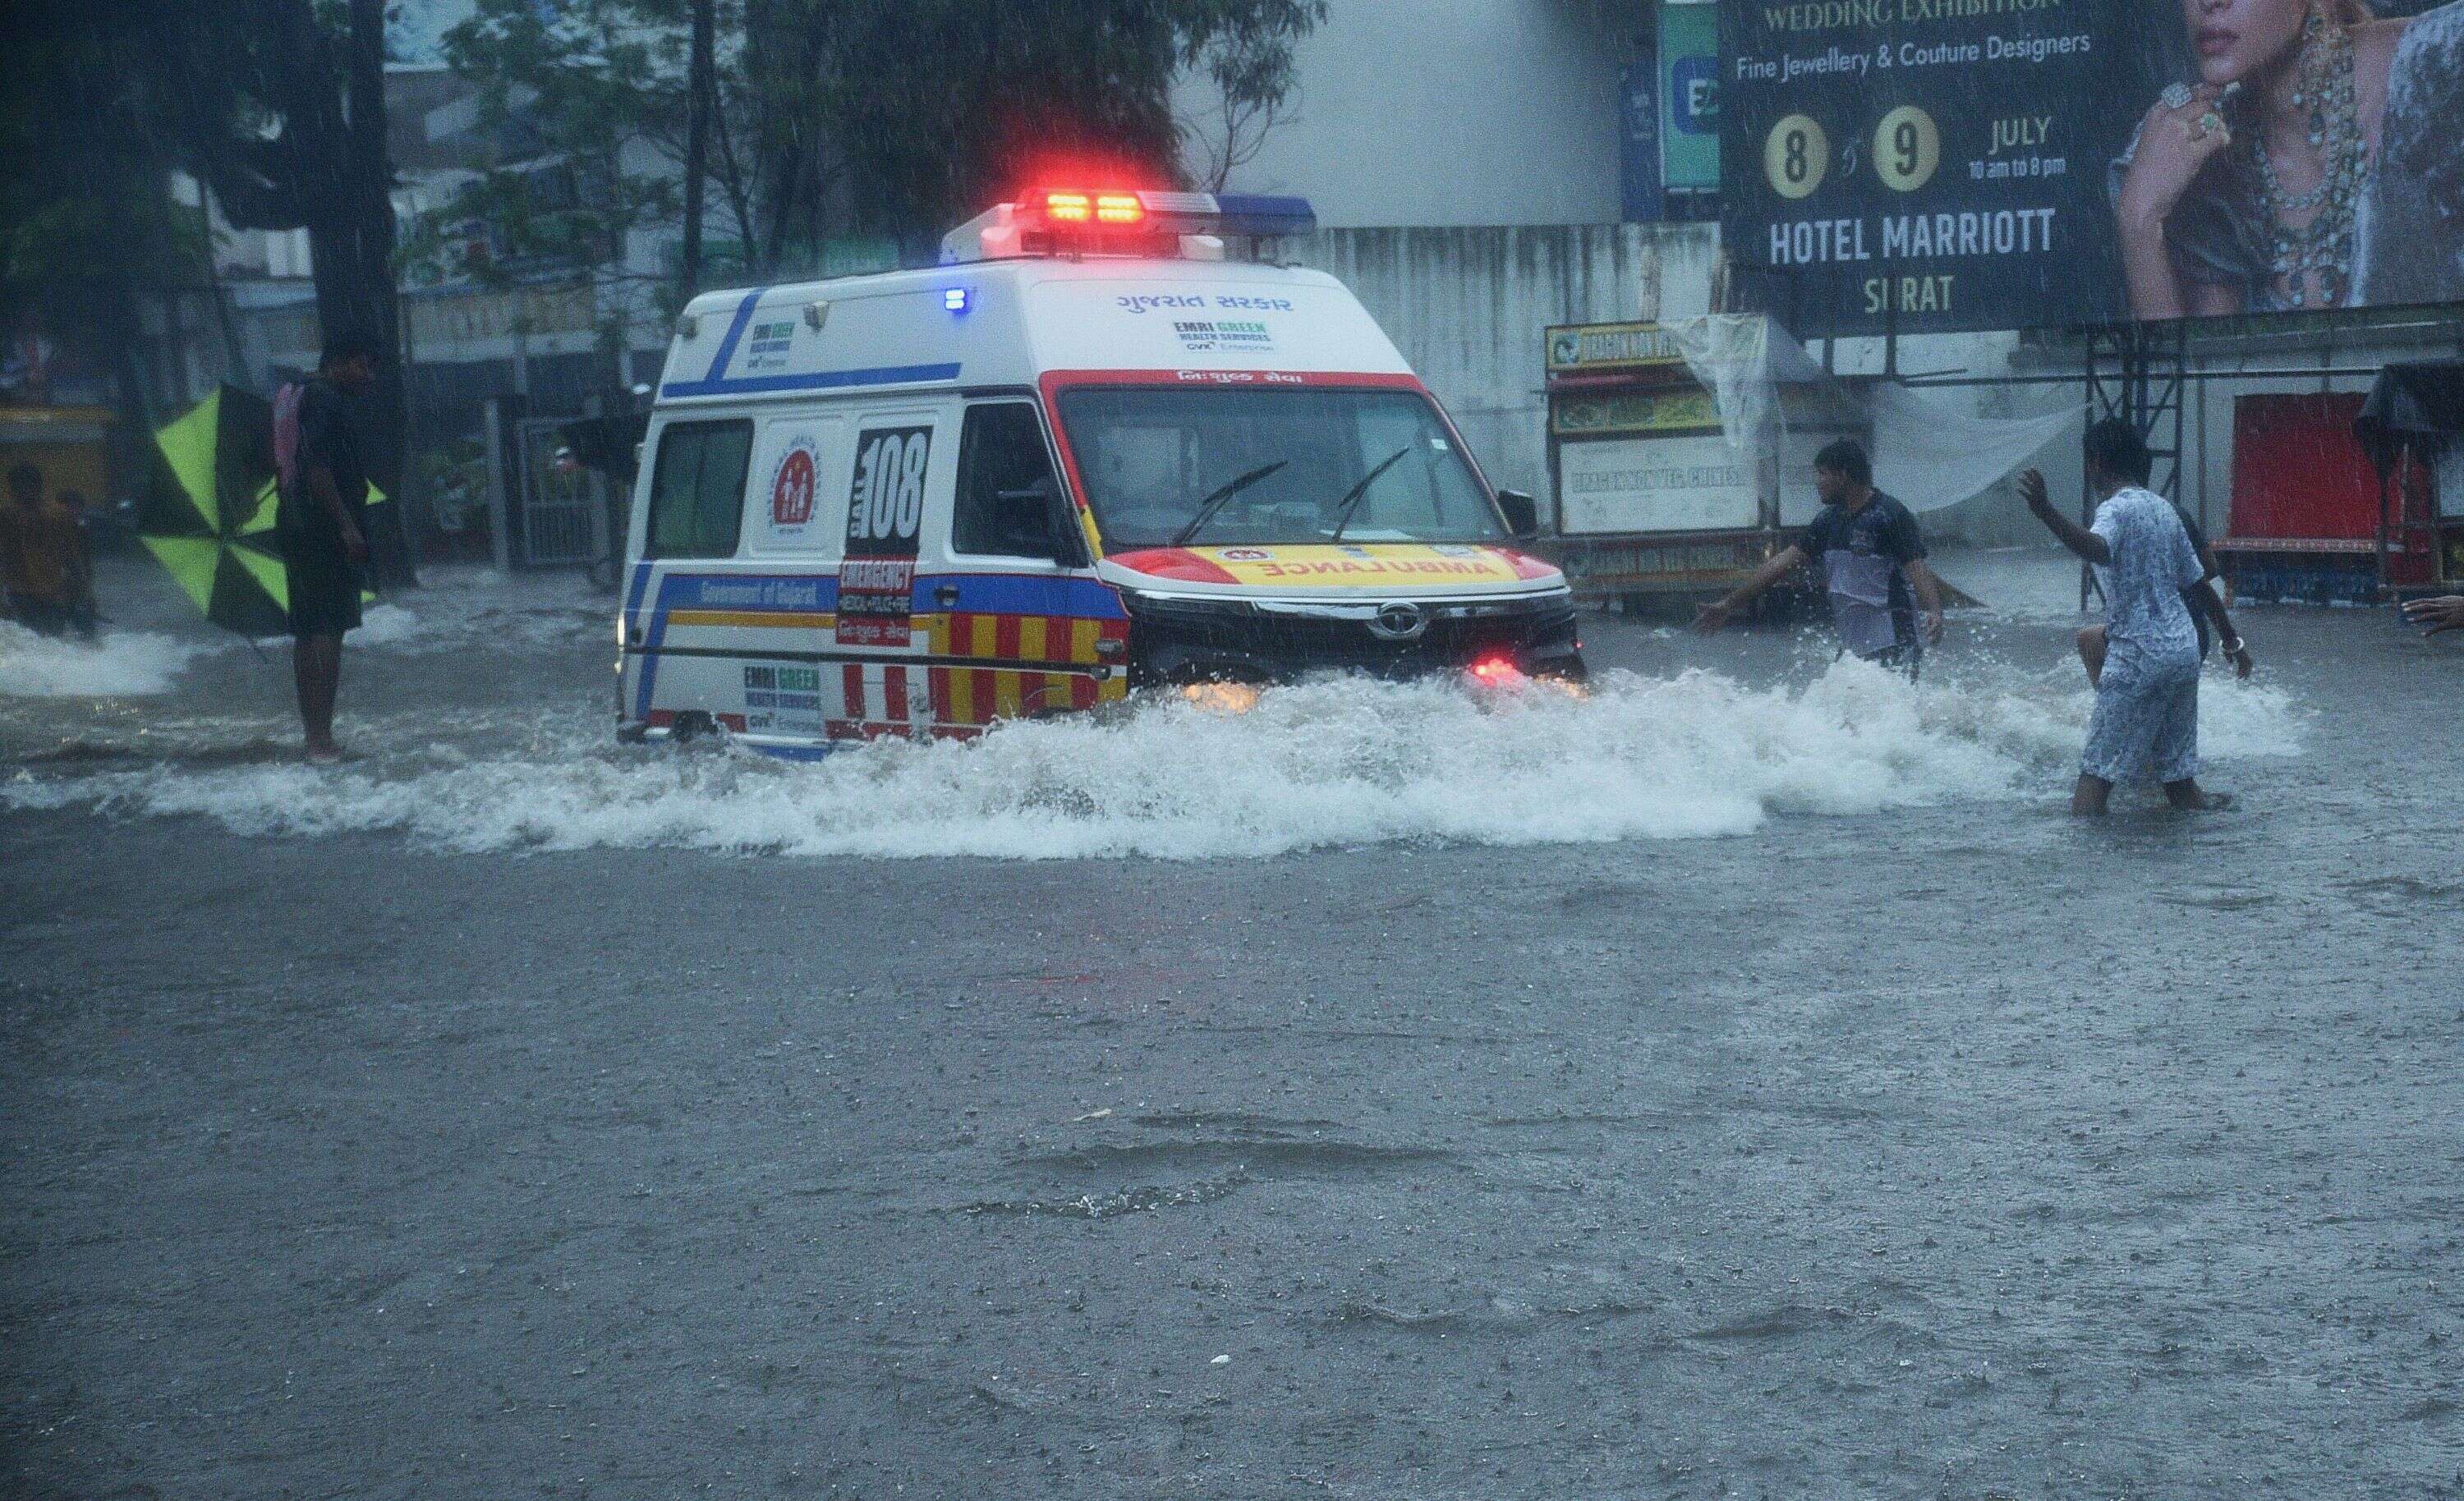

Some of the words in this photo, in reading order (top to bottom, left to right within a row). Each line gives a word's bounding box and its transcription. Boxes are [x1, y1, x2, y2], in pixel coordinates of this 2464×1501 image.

[1764, 0, 1892, 32] WEDDING
[1735, 57, 1777, 80] Fine
[1781, 47, 1872, 83] Jewellery
[1876, 44, 1892, 68] &
[1900, 42, 1980, 67] Couture
[1986, 34, 2091, 62] Designers
[1785, 129, 1807, 182] 8
[1896, 122, 1919, 175] 9
[1988, 116, 2053, 154] JULY
[1986, 161, 2010, 178] am
[2011, 158, 2027, 177] to
[2030, 156, 2040, 176] 8
[2043, 157, 2066, 178] pm
[1769, 218, 1869, 265] HOTEL
[1882, 208, 2056, 259] MARRIOTT
[1116, 295, 1206, 314] ગુજરાત
[1216, 295, 1294, 312] સરકાર
[1174, 321, 1215, 333] EMRI
[1216, 321, 1266, 333] GREEN
[860, 431, 928, 540] 108
[778, 668, 821, 691] GREEN
